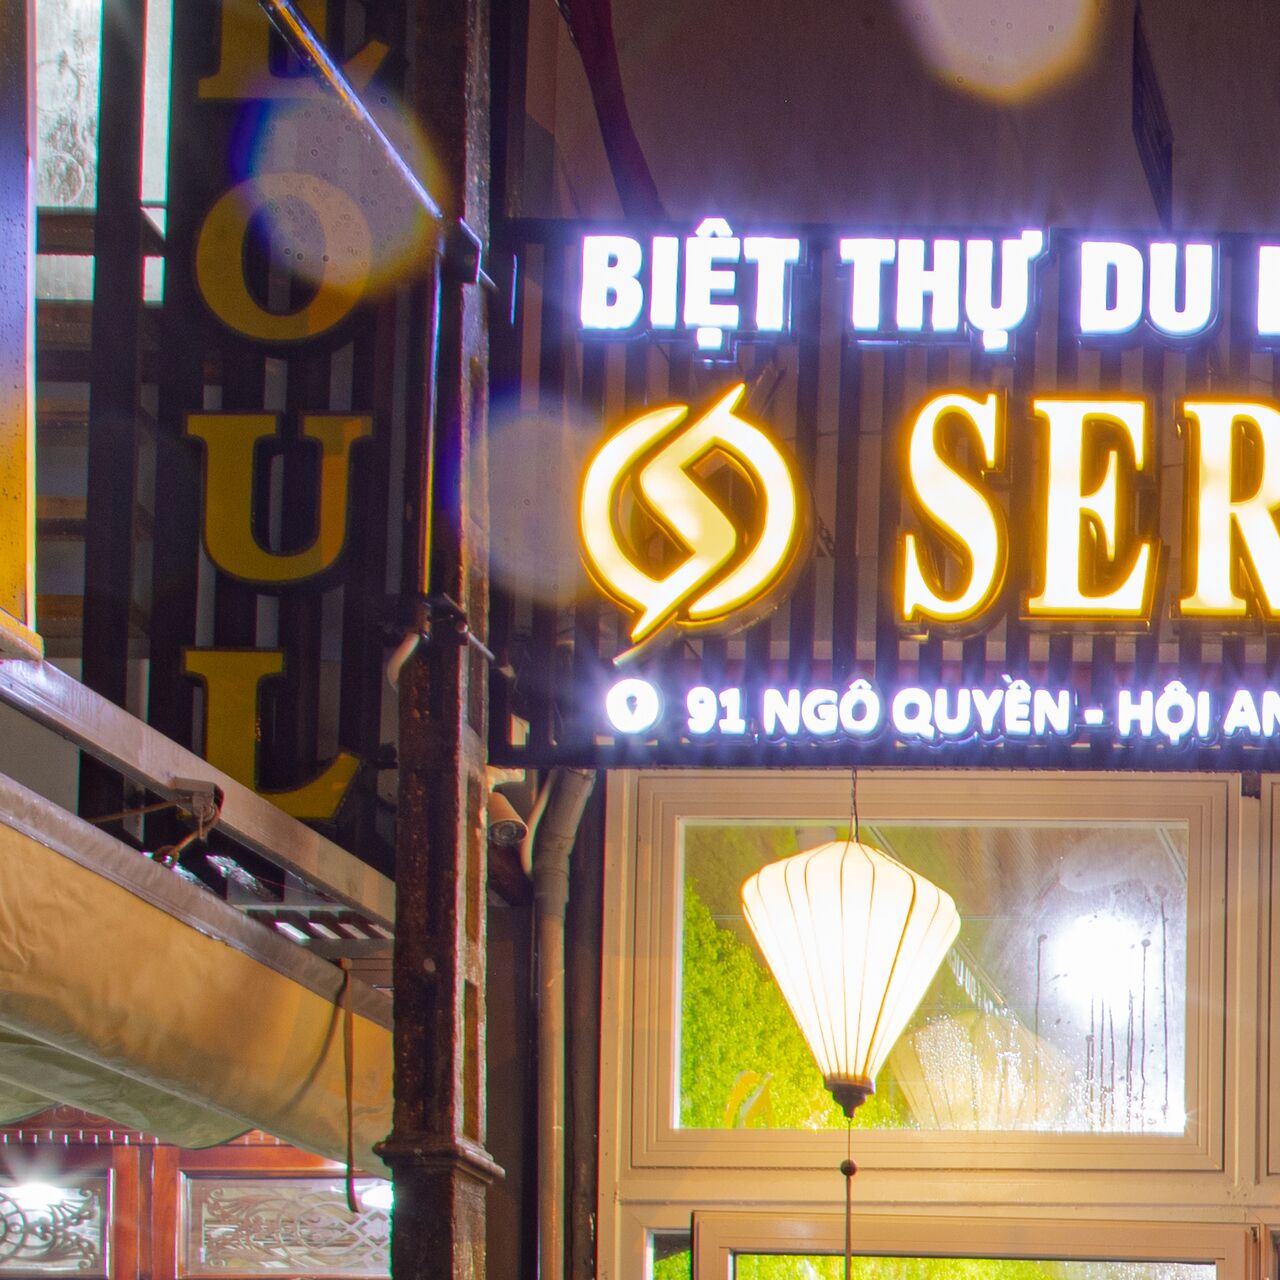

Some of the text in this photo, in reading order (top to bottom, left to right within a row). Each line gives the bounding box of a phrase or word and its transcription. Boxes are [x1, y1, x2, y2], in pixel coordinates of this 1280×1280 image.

[580, 218, 799, 347] BIỆT
[840, 230, 1043, 350] THỰ
[1080, 241, 1212, 332] DU
[685, 686, 746, 733] 91
[763, 679, 880, 733] NGÔ
[892, 674, 1070, 738] QUYỀN
[1118, 680, 1211, 741] HỘI
